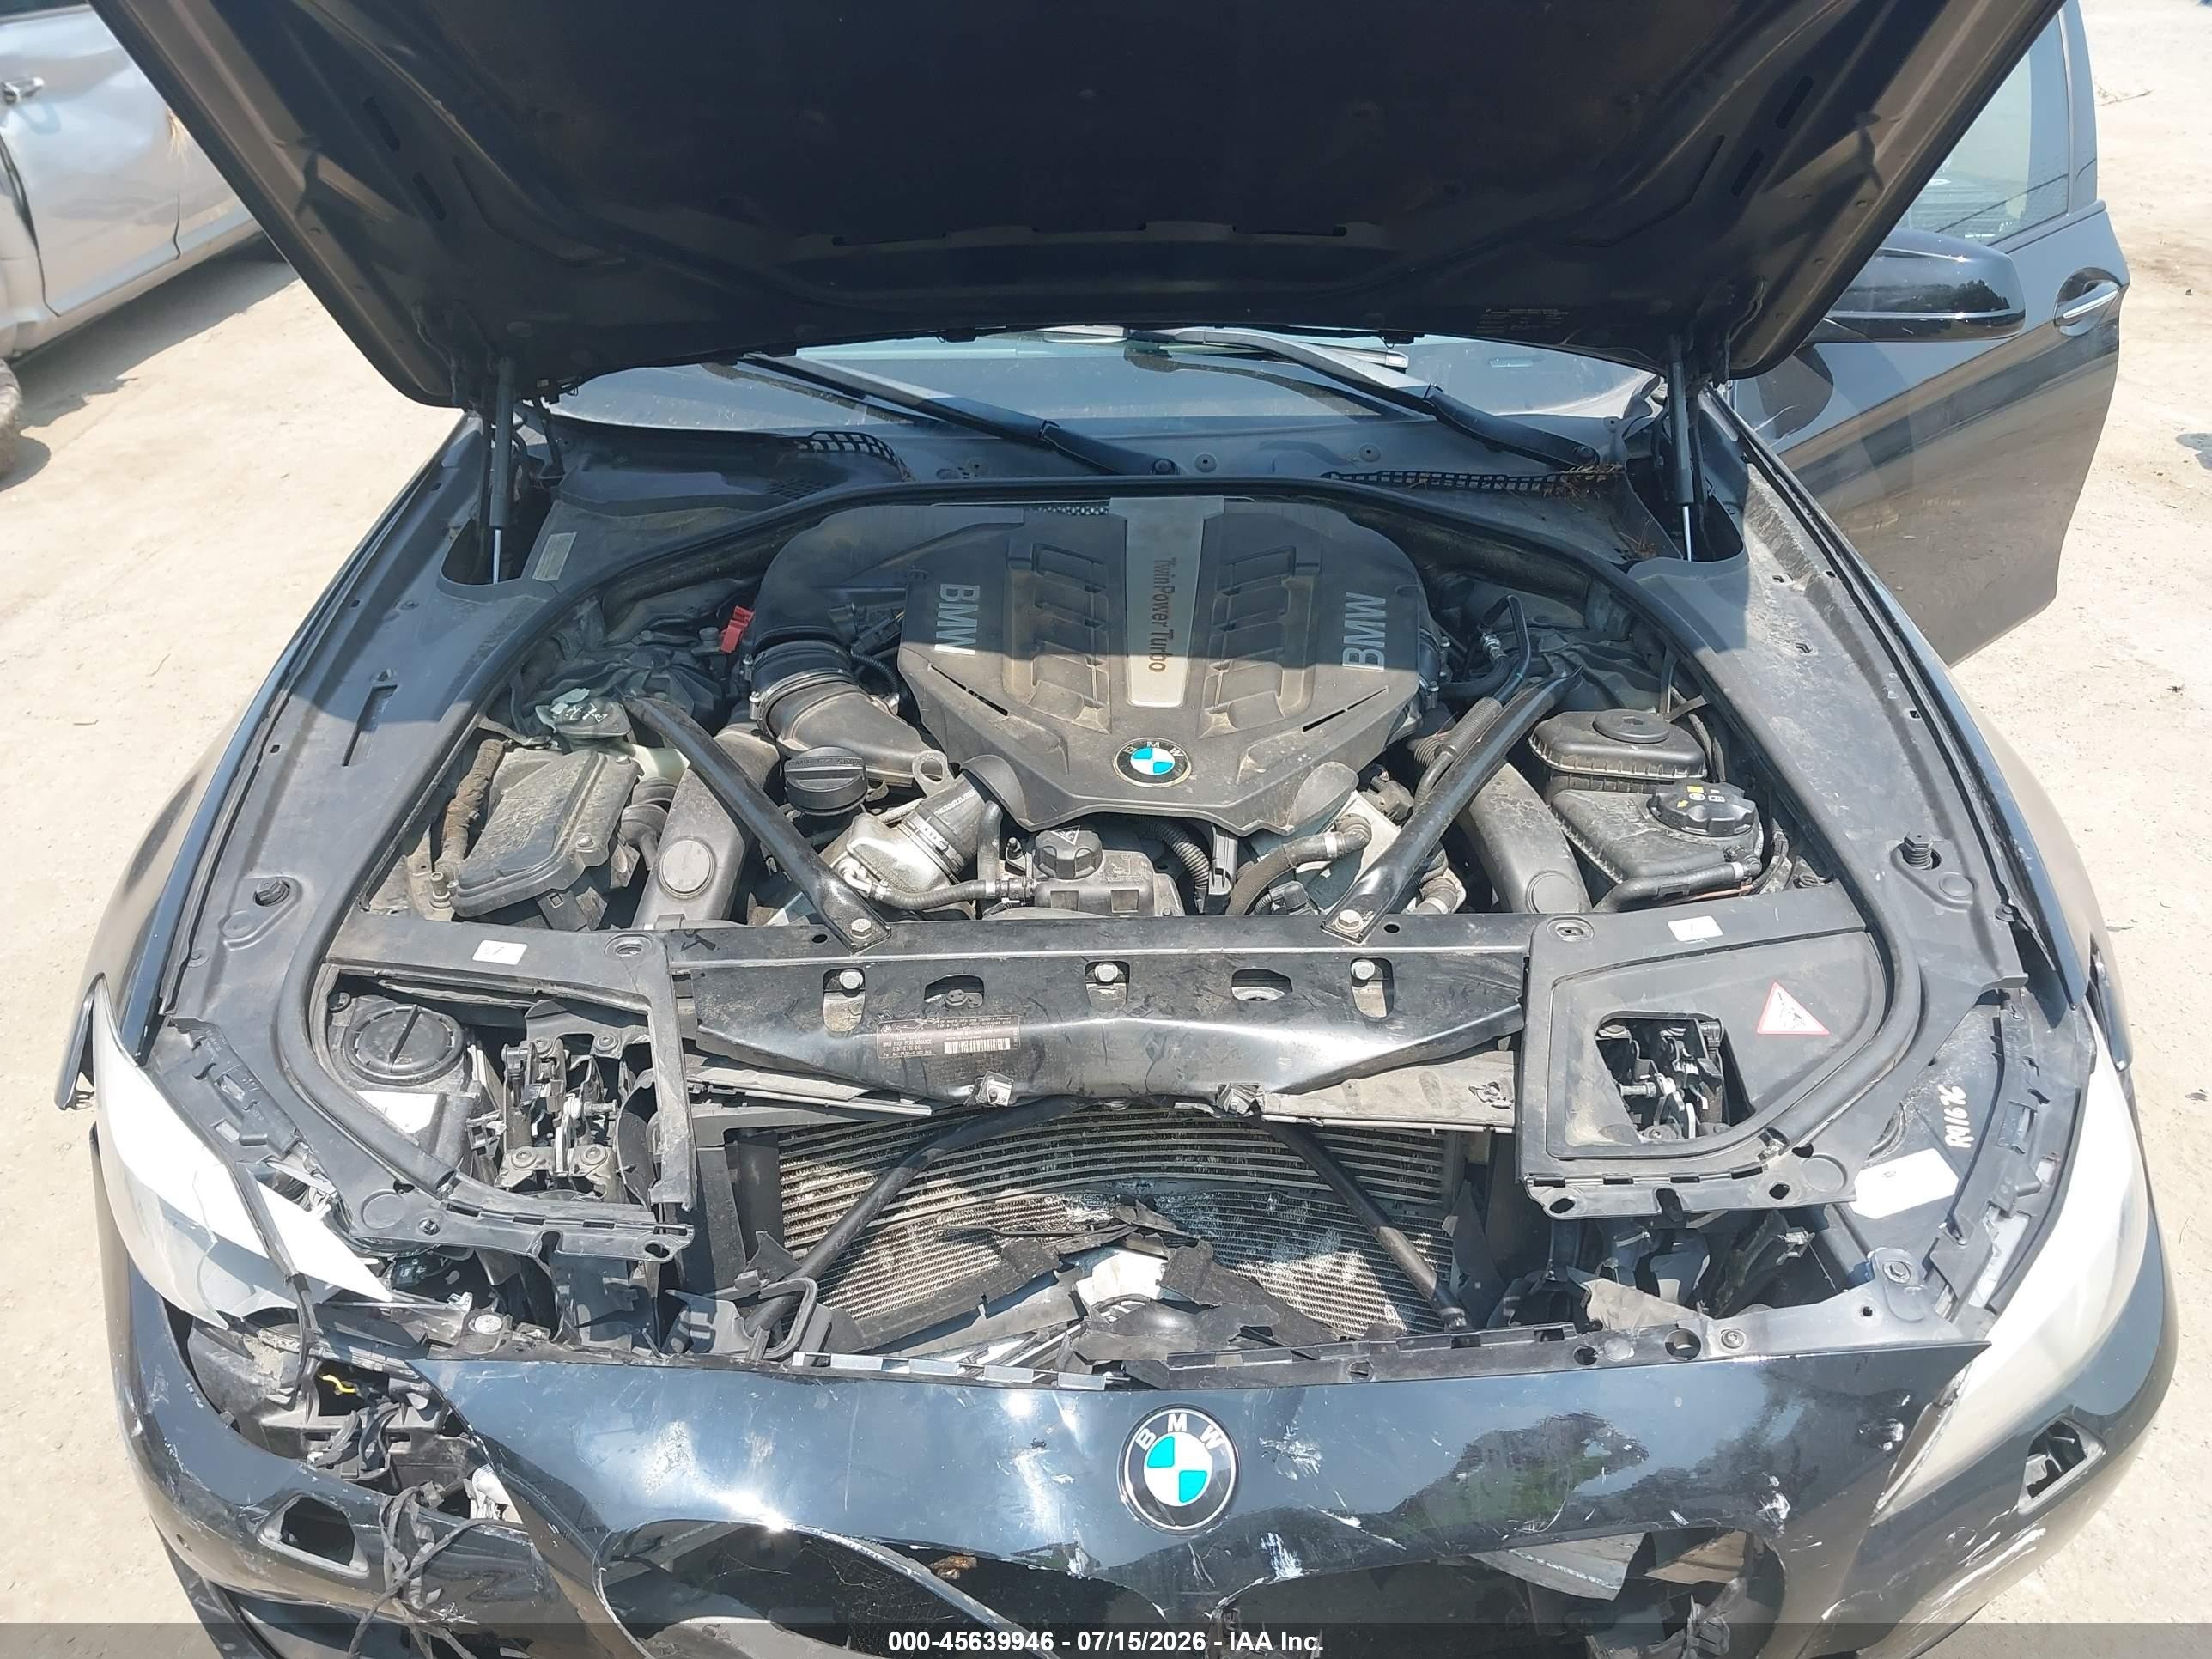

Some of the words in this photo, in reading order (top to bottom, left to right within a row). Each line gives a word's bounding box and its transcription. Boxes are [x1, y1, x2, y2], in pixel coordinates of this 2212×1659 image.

[934, 584, 980, 656] BMW
[1342, 592, 1386, 672] BMW
[1149, 629, 1174, 672] Turbo
[1123, 741, 1185, 757] BMW
[1134, 1413, 1225, 1451] BMW
